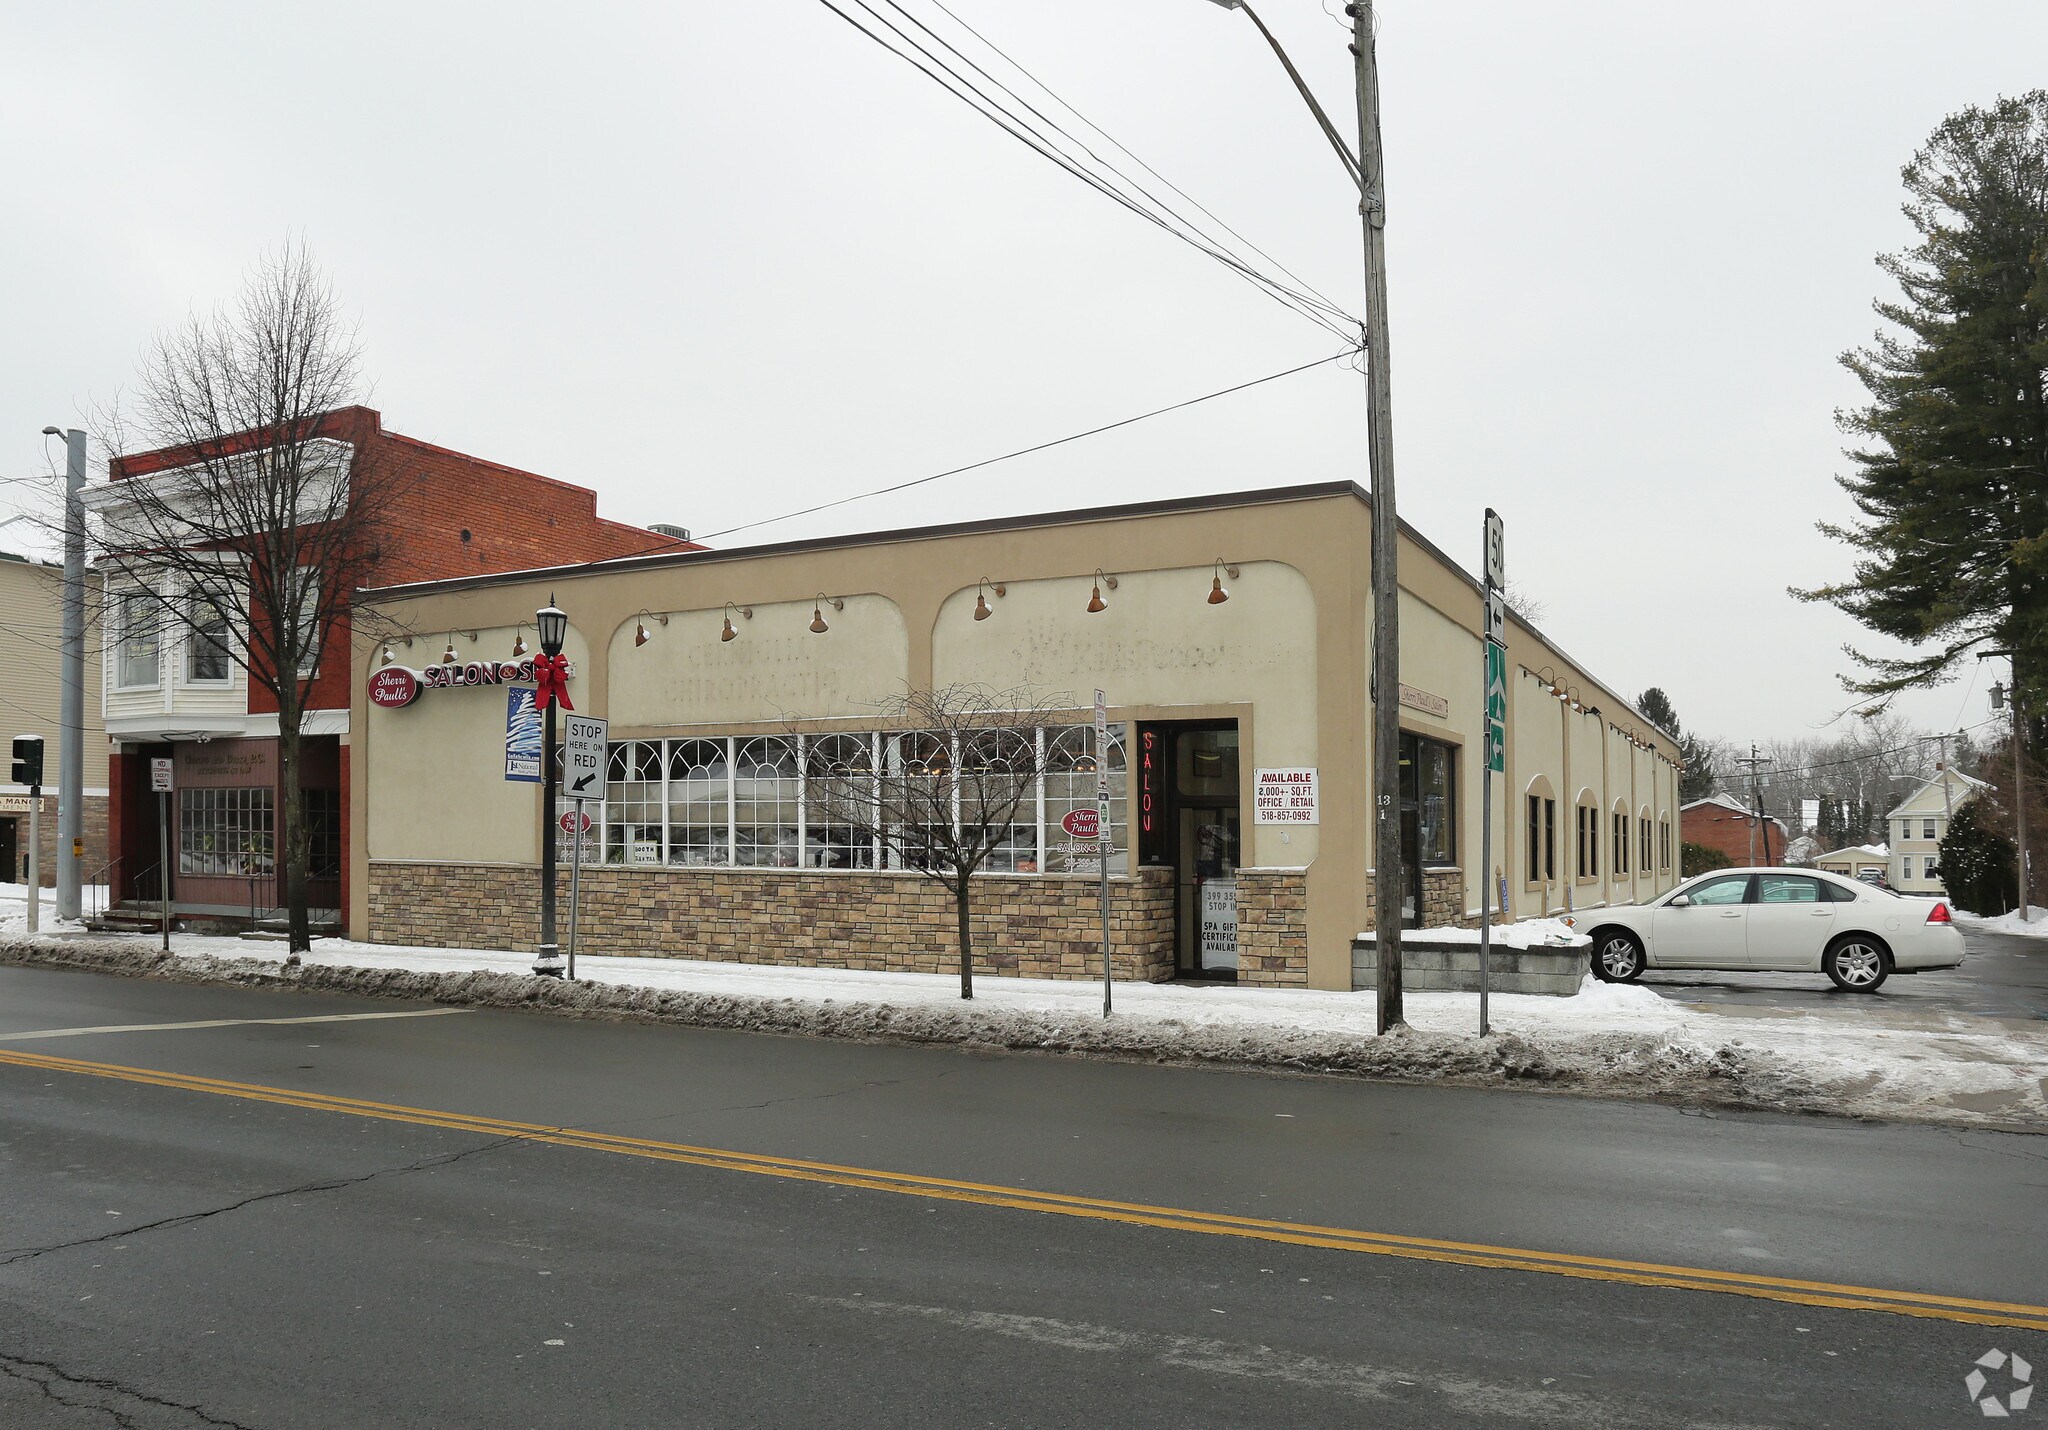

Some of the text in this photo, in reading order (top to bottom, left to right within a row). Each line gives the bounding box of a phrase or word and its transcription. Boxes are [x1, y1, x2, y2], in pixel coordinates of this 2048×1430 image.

[1491, 529, 1503, 574] 50
[377, 672, 407, 686] Sherri
[423, 662, 497, 688] SALON
[374, 687, 407, 702] Paull's
[571, 724, 602, 739] STOP
[569, 741, 603, 752] HERE ON
[574, 754, 597, 768] RED
[1261, 773, 1311, 783] AVAILABLE
[1258, 787, 1288, 796] 2,000+-
[1258, 797, 1282, 807] OFFICE
[1290, 797, 1314, 807] RETAIL
[1377, 794, 1391, 806] 13
[1072, 811, 1098, 822] Sherri
[1261, 811, 1311, 821] 518-857-0992
[1380, 809, 1386, 820] 1
[1207, 892, 1221, 901] 399
[1208, 902, 1227, 911] STOP
[1204, 922, 1218, 931] SPA
